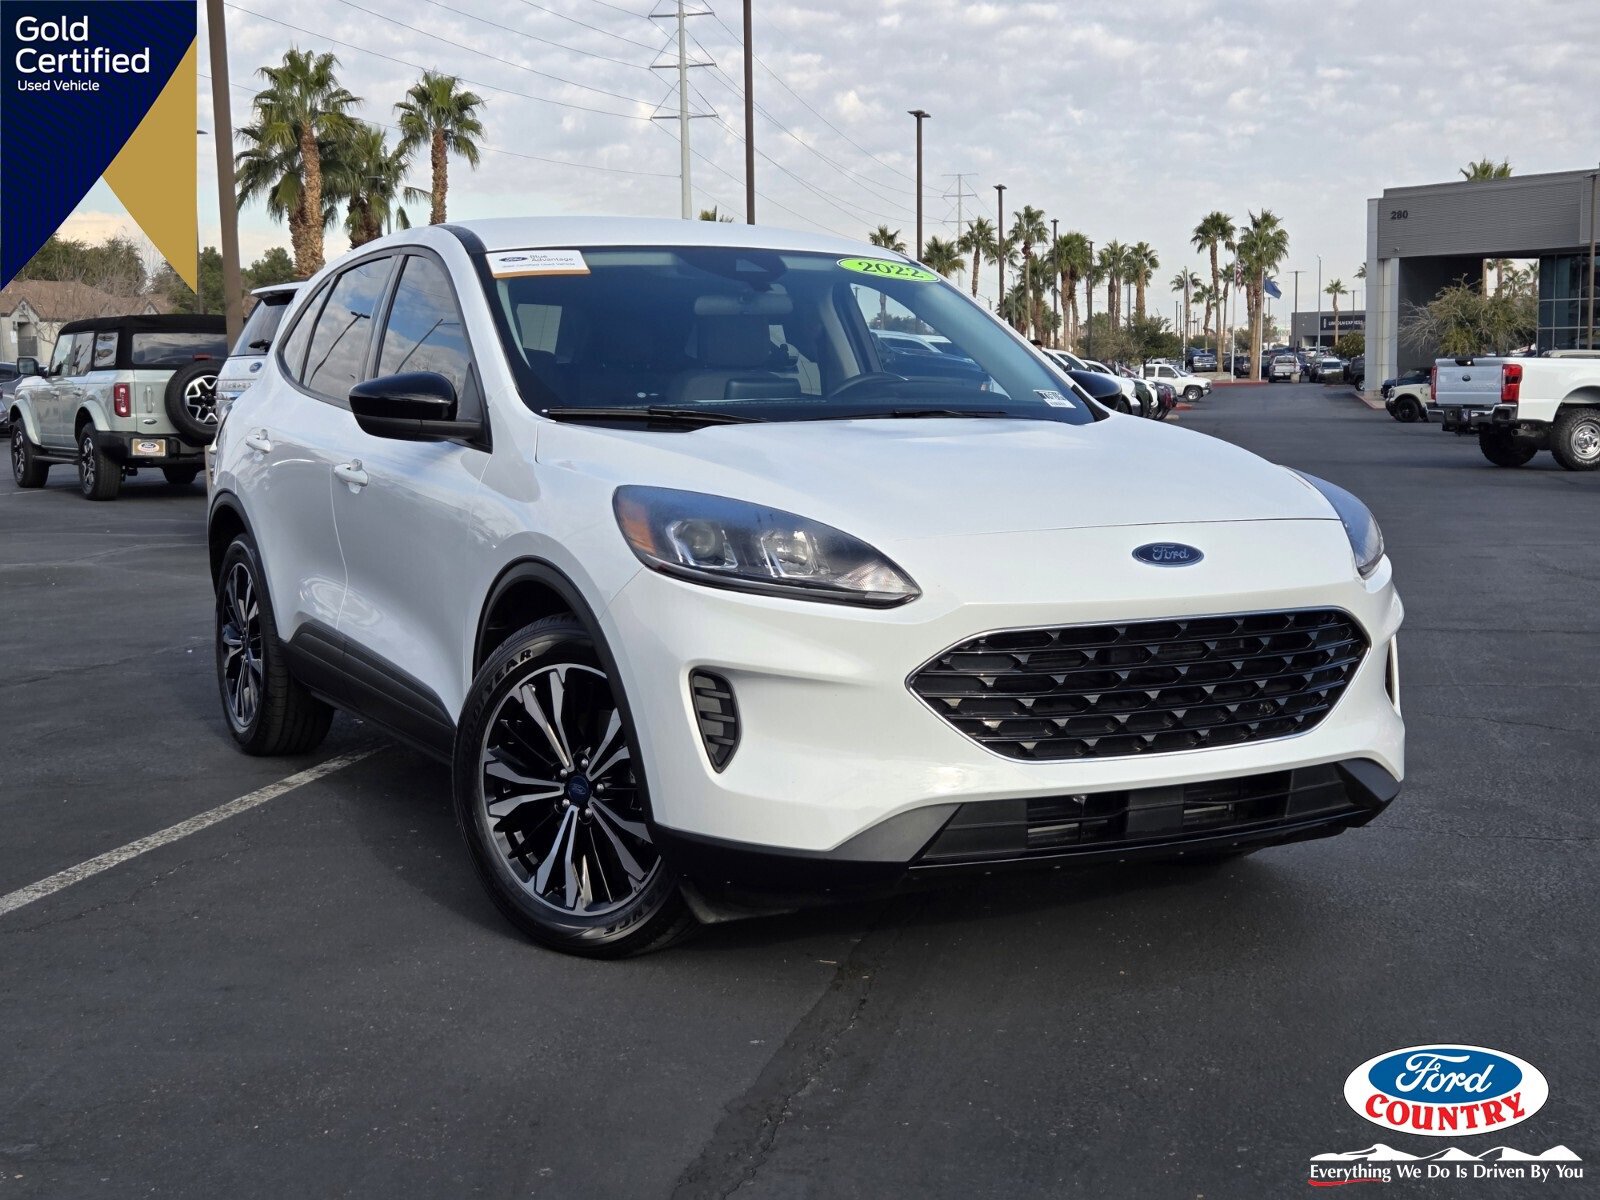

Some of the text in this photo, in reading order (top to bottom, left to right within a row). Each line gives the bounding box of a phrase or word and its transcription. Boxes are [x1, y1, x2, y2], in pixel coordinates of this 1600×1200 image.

[1390, 210, 1408, 220] 280
[858, 262, 924, 278] 2022
[1152, 544, 1190, 561] Ford
